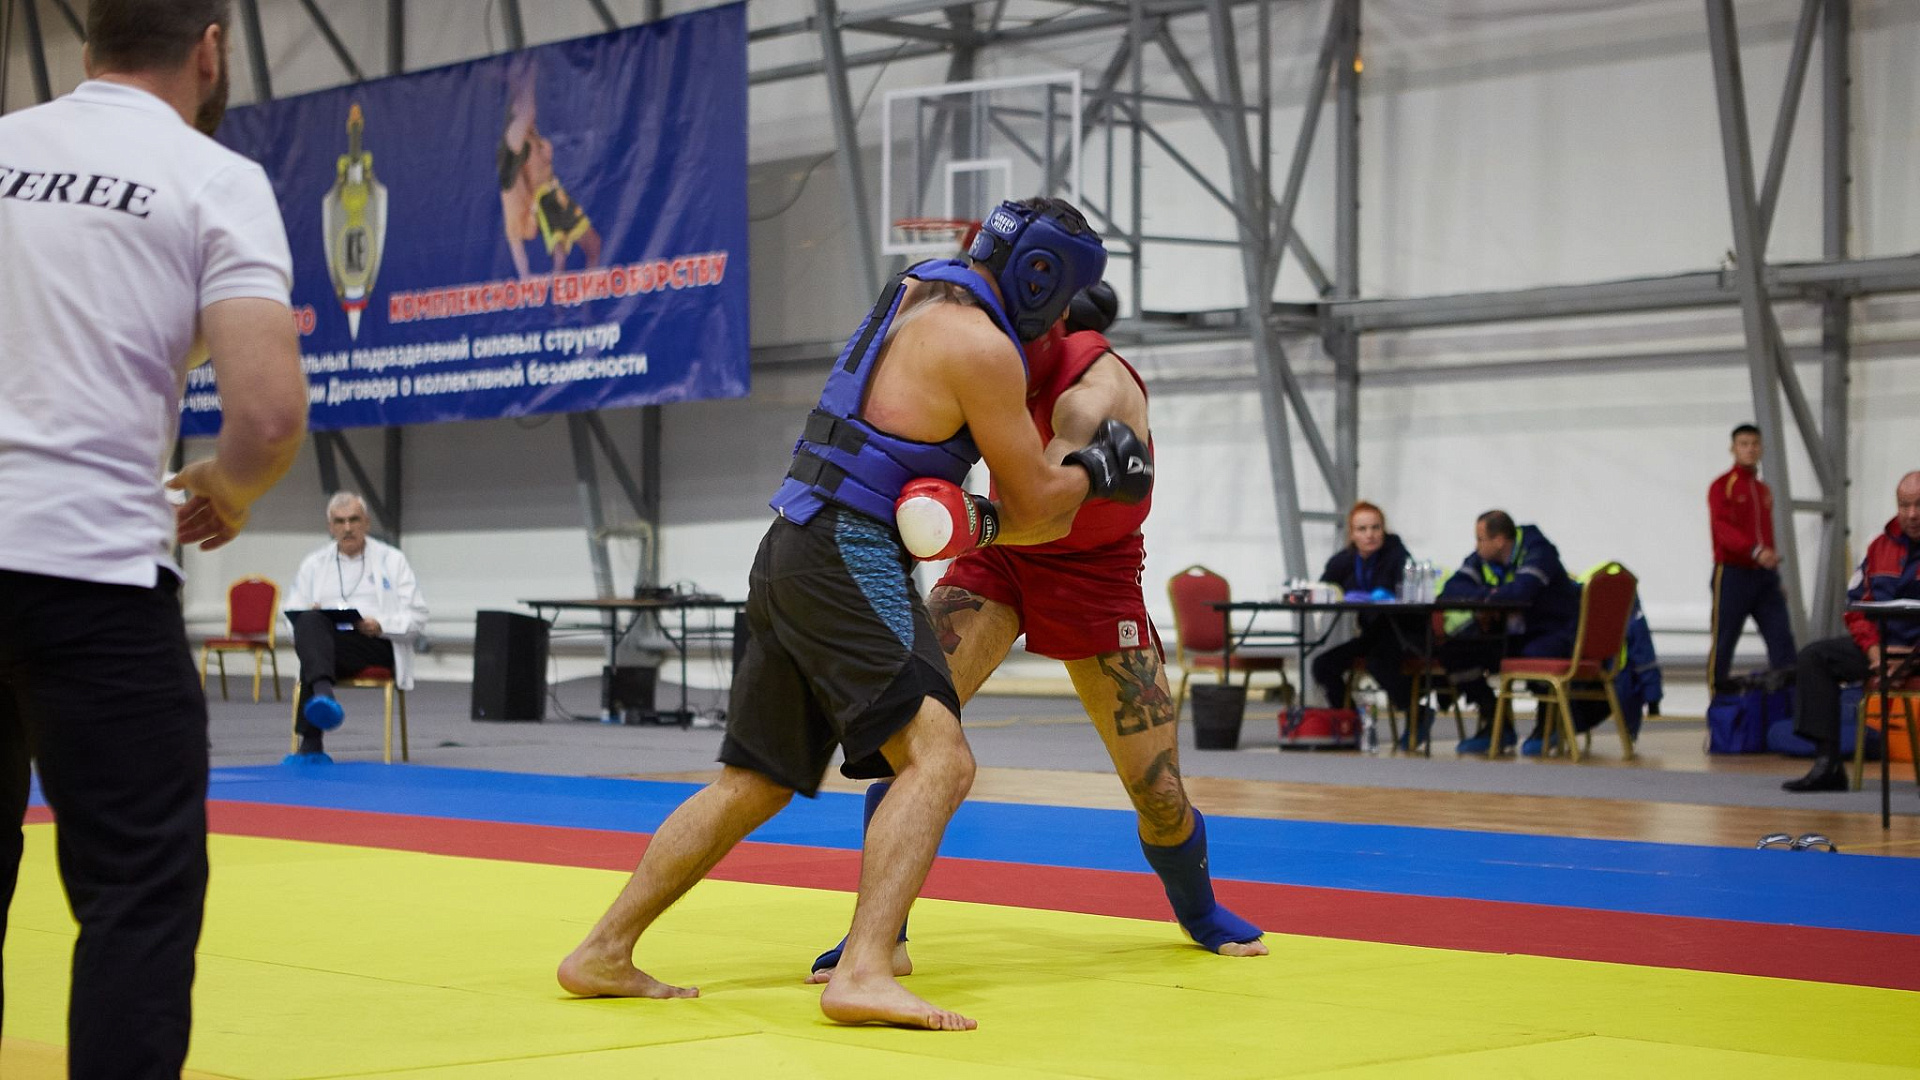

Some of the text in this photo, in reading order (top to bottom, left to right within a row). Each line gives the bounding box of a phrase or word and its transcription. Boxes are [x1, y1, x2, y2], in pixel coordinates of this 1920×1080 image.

[389, 274, 549, 324] КОМПЛЕКСНОМУ
[552, 251, 728, 307] ЕДИНОБОРСТВУ
[351, 333, 470, 373] подразделений
[472, 332, 542, 359] силовых
[544, 321, 621, 356] структур
[327, 376, 398, 406] Договора
[400, 375, 412, 397] о
[414, 360, 525, 395] коллективной
[527, 353, 648, 386] безопасности
